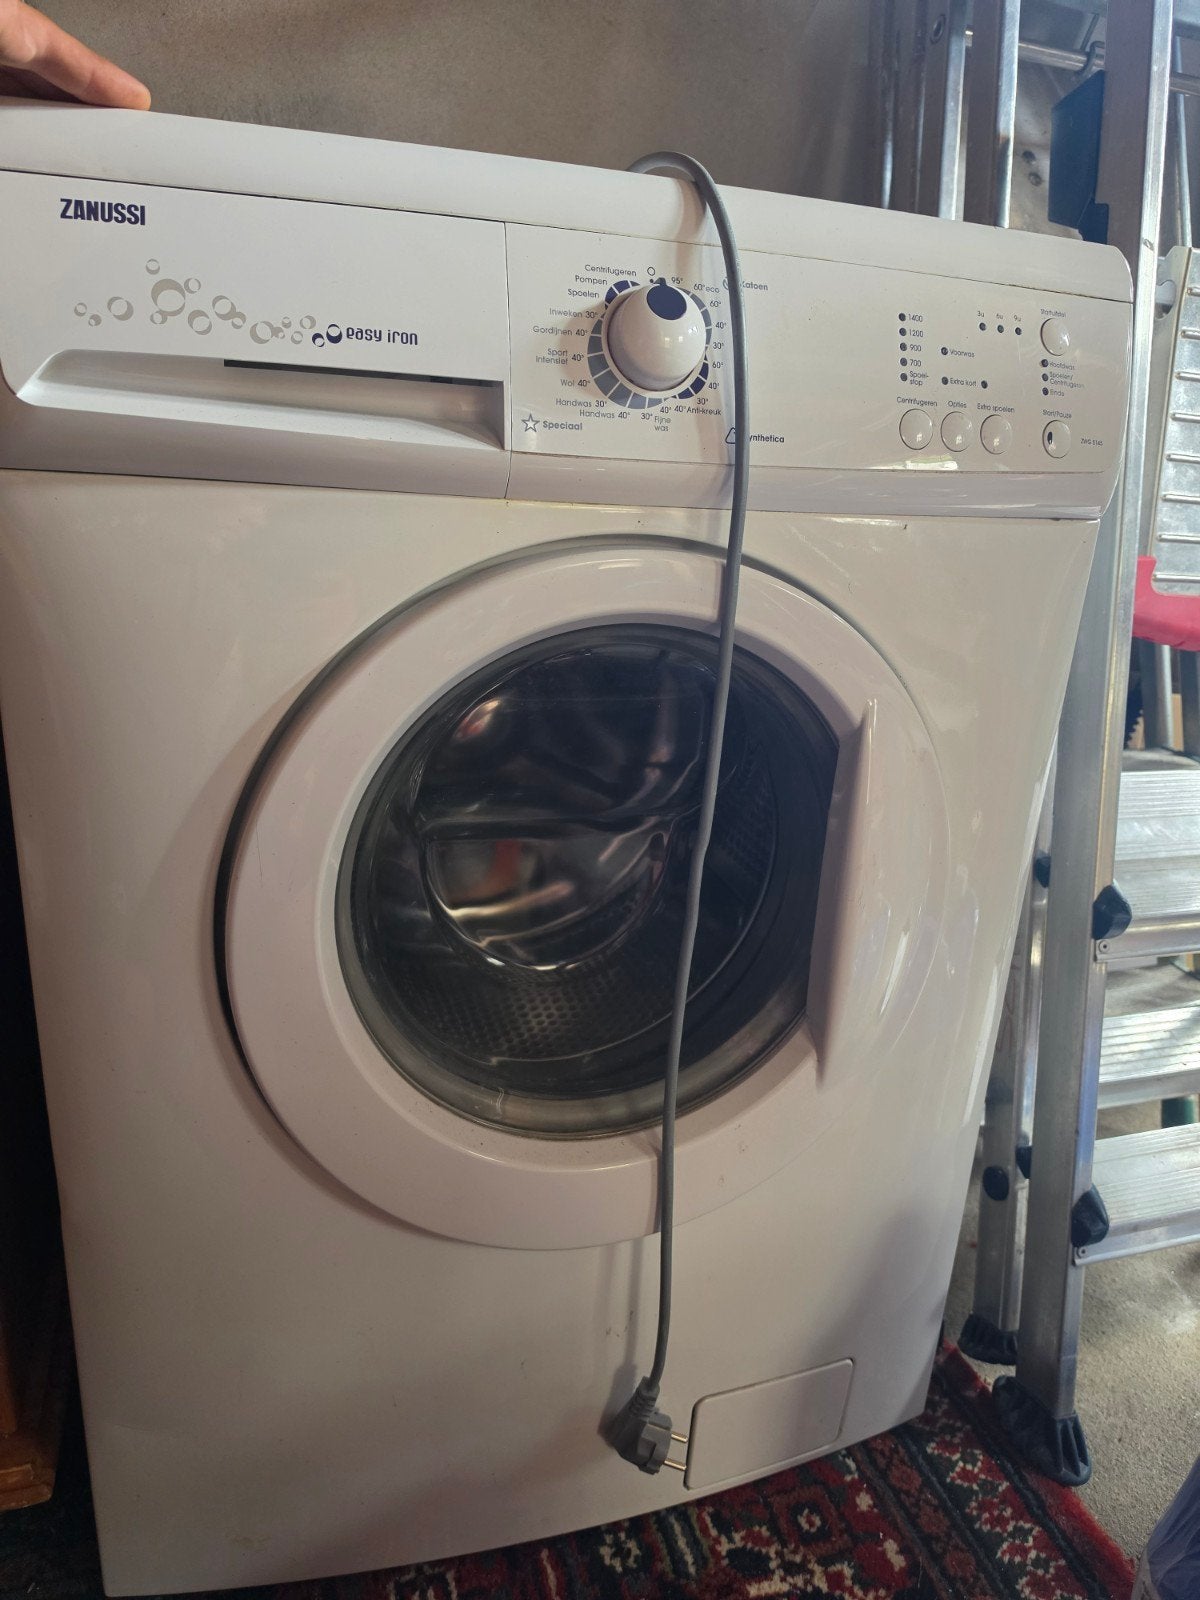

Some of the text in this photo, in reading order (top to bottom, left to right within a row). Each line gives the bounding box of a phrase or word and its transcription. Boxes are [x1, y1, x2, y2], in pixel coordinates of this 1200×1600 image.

[60, 198, 146, 226] ZANUSSI
[585, 264, 637, 277] Centrifugeren
[575, 275, 608, 286] Pompen
[671, 276, 683, 285] 95°
[567, 288, 600, 299] Spoelen
[709, 300, 721, 308] 60°
[549, 308, 598, 319] Inweken 30°
[909, 314, 923, 323] 1400
[715, 321, 727, 329] 40°
[532, 325, 588, 337] Gordijnen 40°
[909, 329, 924, 338] 1200
[346, 326, 419, 346] easy iron
[712, 341, 724, 350] 30°
[909, 344, 922, 352] 900
[547, 348, 568, 358] Sport
[571, 353, 585, 362] 40°
[712, 361, 724, 369] 60°
[909, 359, 922, 367] 700
[560, 379, 591, 388] Wol 40°
[708, 382, 720, 390] 40°
[950, 377, 965, 386] Extra
[556, 398, 607, 408] Handwas 30°
[697, 397, 709, 405] 30°
[896, 396, 938, 408] Centrifugeren
[580, 409, 631, 420] Handwas 40°
[641, 413, 653, 421] 30°
[542, 420, 583, 431] Speciaal
